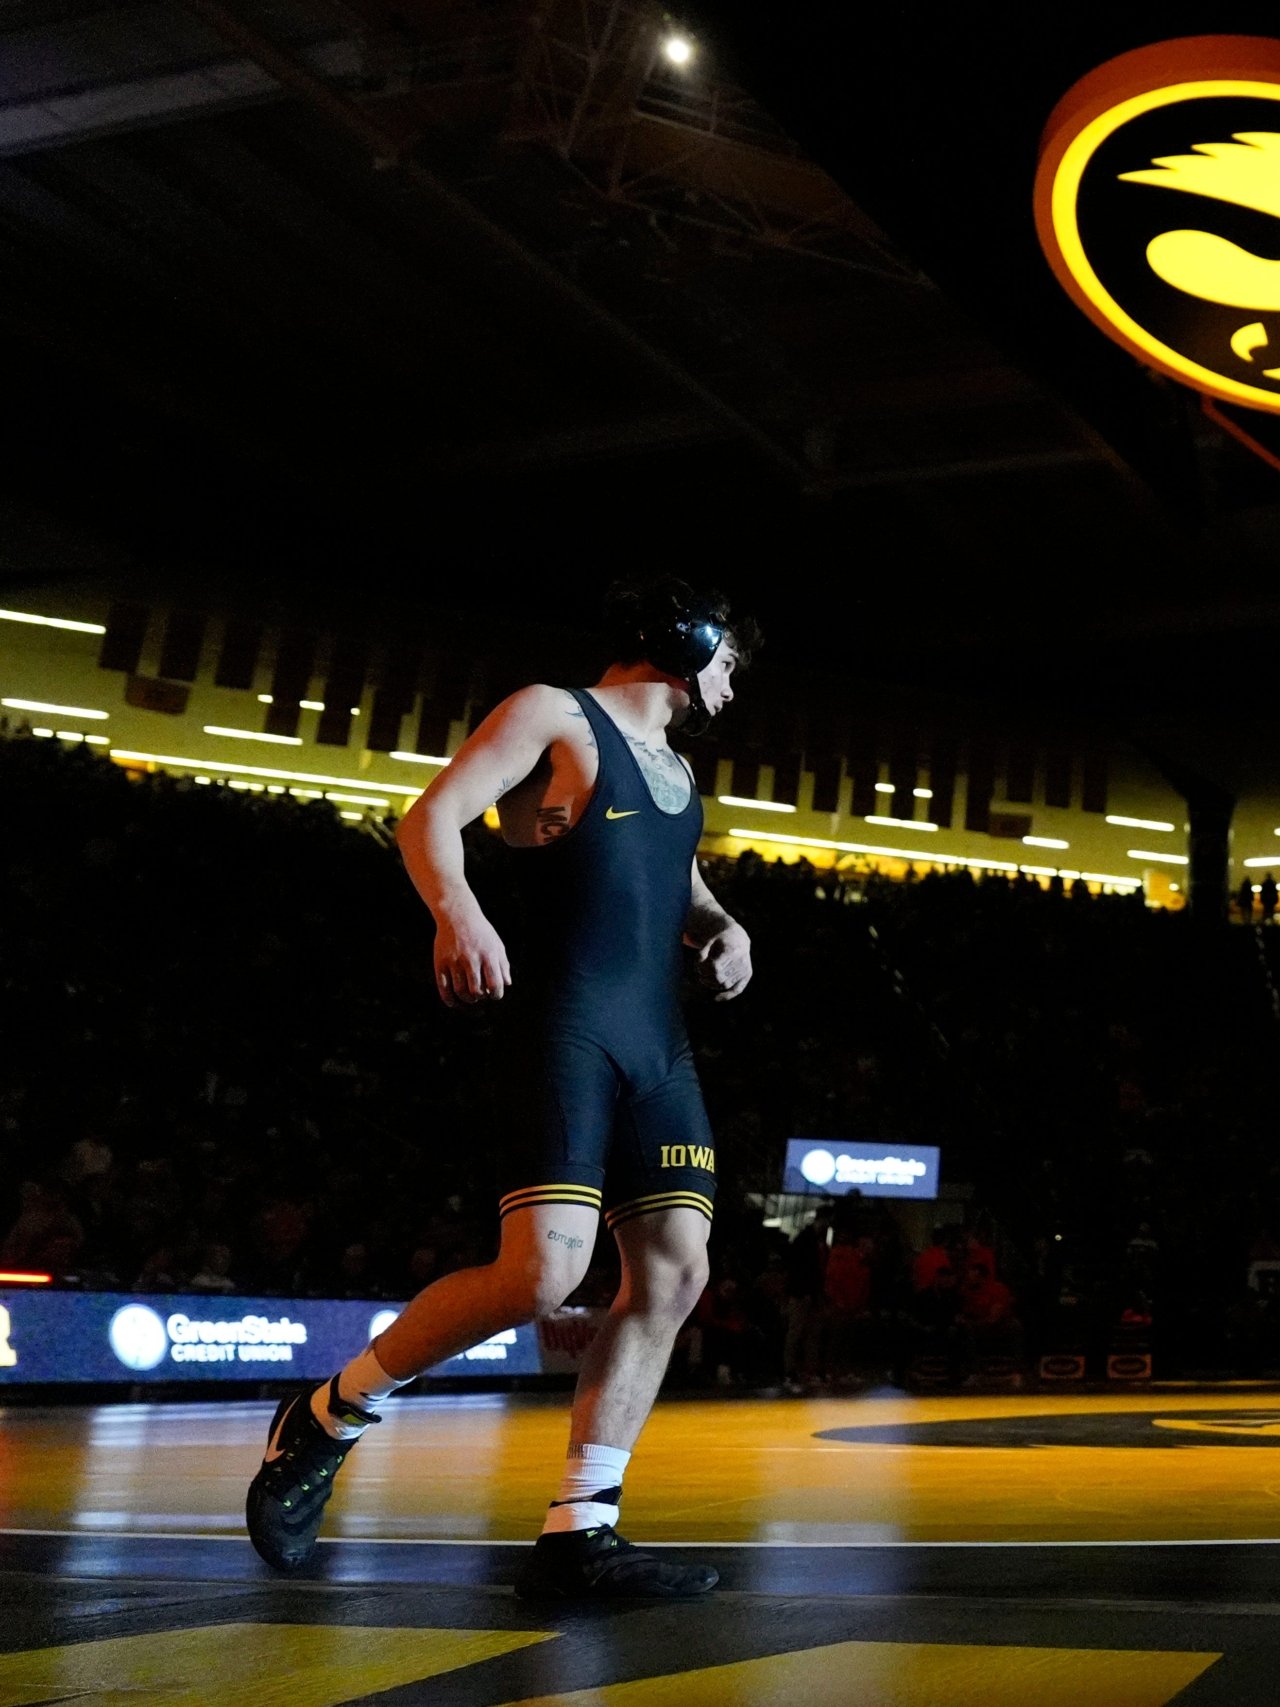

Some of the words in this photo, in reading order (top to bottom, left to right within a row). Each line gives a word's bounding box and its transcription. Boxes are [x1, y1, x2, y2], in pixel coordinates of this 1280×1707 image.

[661, 1145, 715, 1173] IOWA
[167, 1314, 307, 1344] GreenState
[171, 1344, 235, 1362] CREDIT
[238, 1344, 292, 1362] UNION
